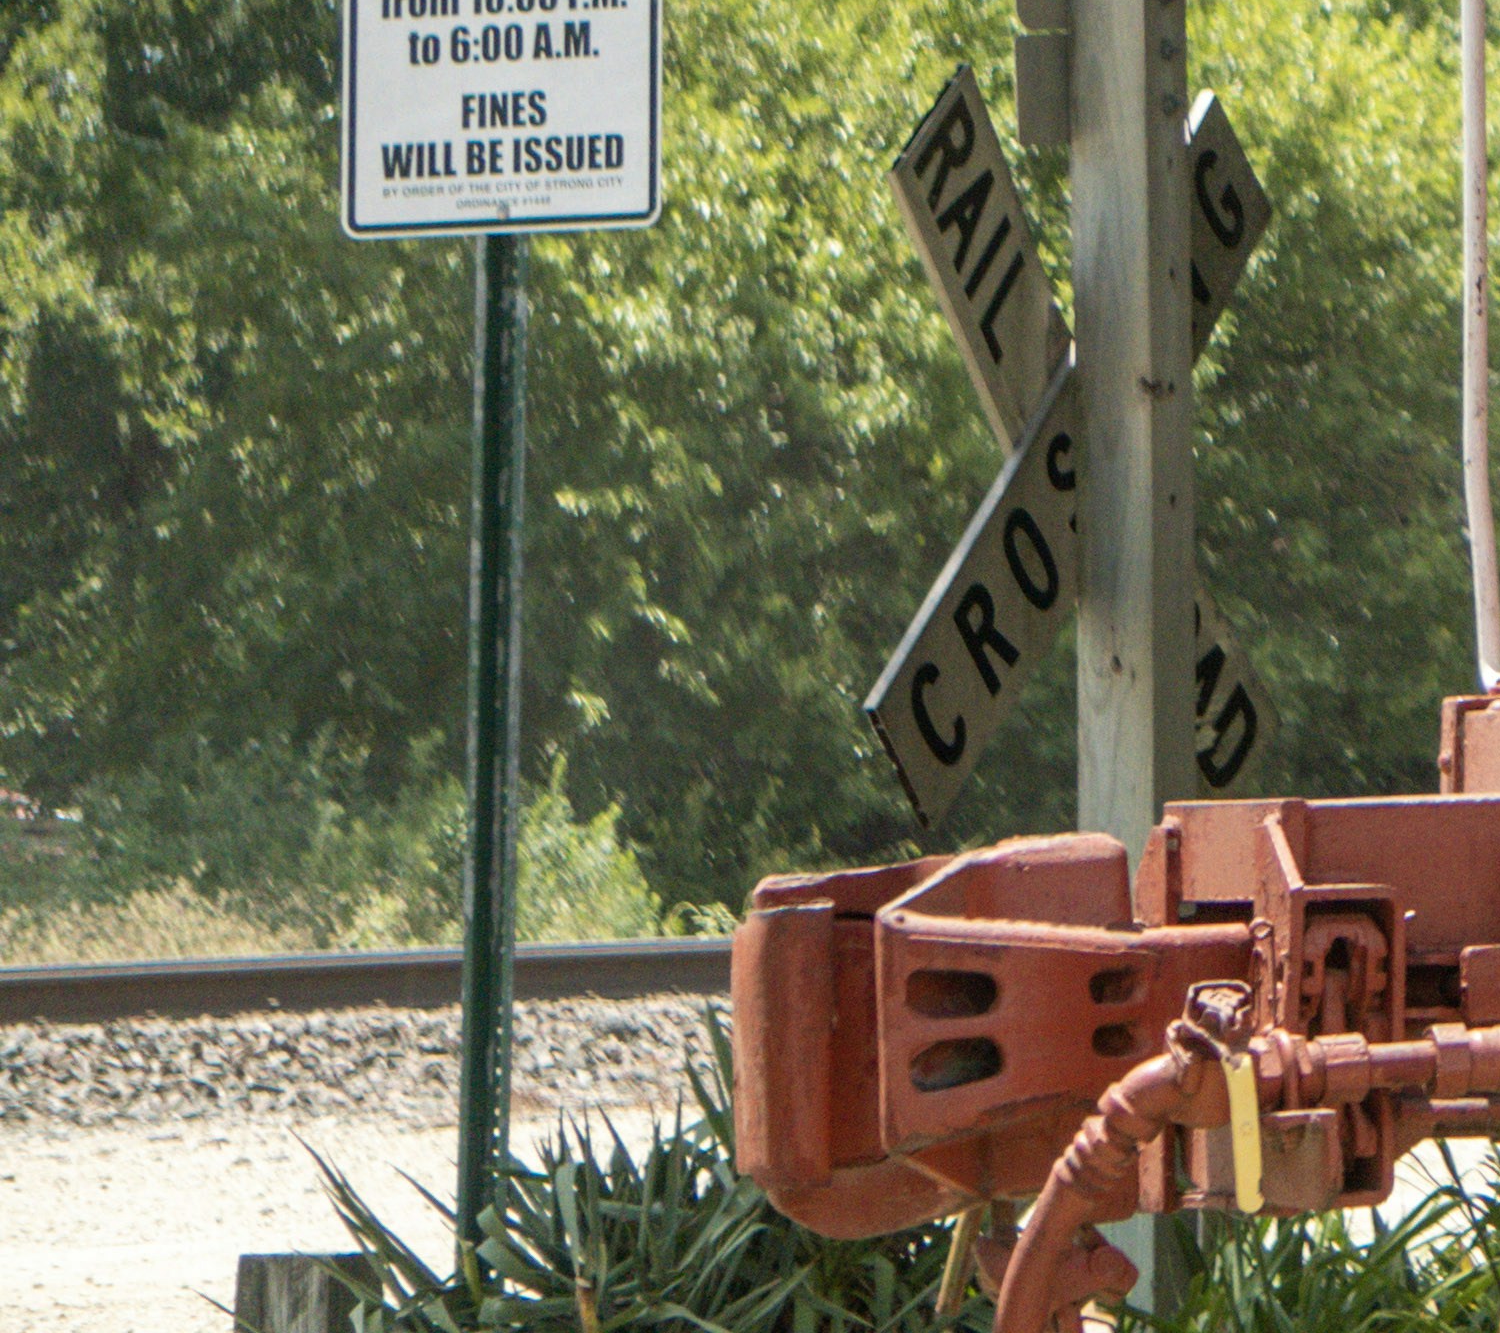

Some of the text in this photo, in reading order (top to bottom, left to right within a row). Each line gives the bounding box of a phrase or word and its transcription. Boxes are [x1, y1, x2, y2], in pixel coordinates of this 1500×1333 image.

[409, 20, 599, 65] to 6:00 A.M.
[462, 90, 547, 130] FINES
[381, 134, 624, 180] WILL BE ISSUED
[383, 188, 398, 198] BY
[402, 186, 444, 197] ORDER
[451, 184, 463, 194] OF
[469, 183, 491, 194] THE
[913, 94, 1025, 364] RAIL
